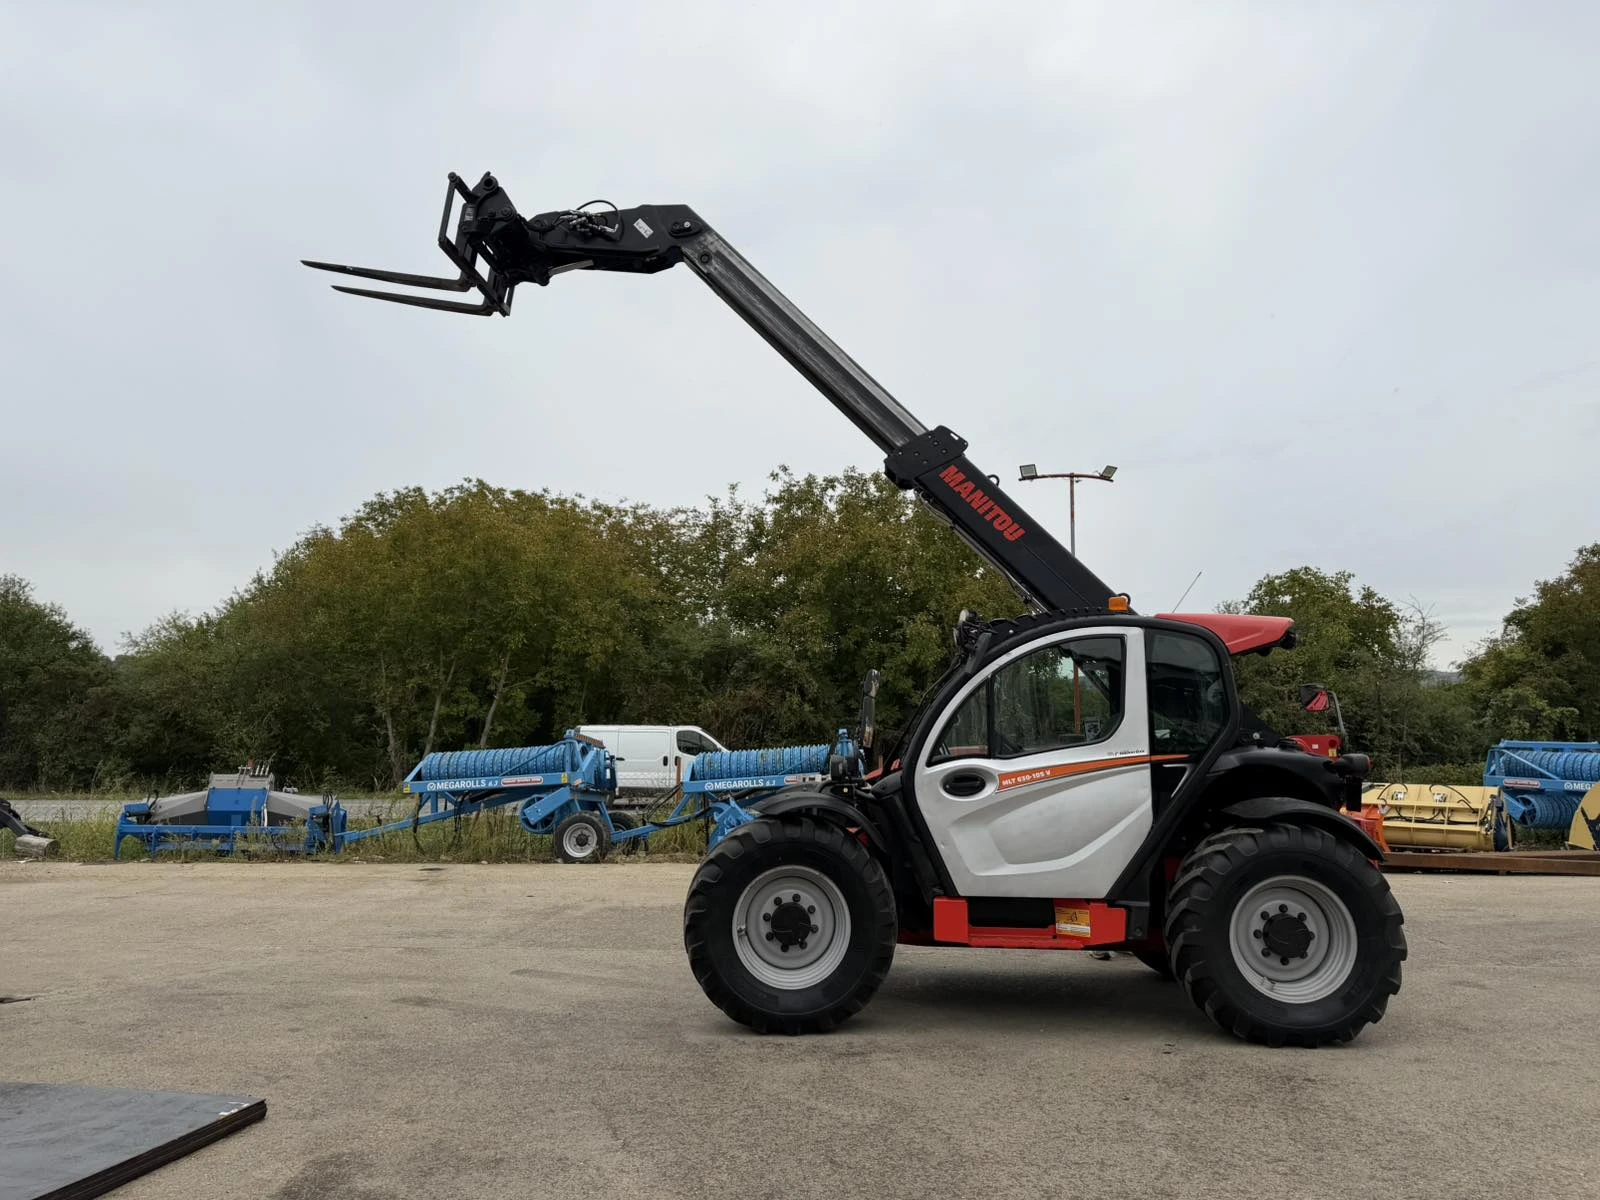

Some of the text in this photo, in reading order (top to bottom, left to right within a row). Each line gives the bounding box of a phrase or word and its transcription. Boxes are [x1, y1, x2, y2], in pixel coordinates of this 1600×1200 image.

[939, 465, 1025, 542] MANITOU
[437, 779, 486, 790] MEGAROLLS
[714, 779, 764, 790] MEGAROLLS
[1002, 777, 1016, 786] MLT
